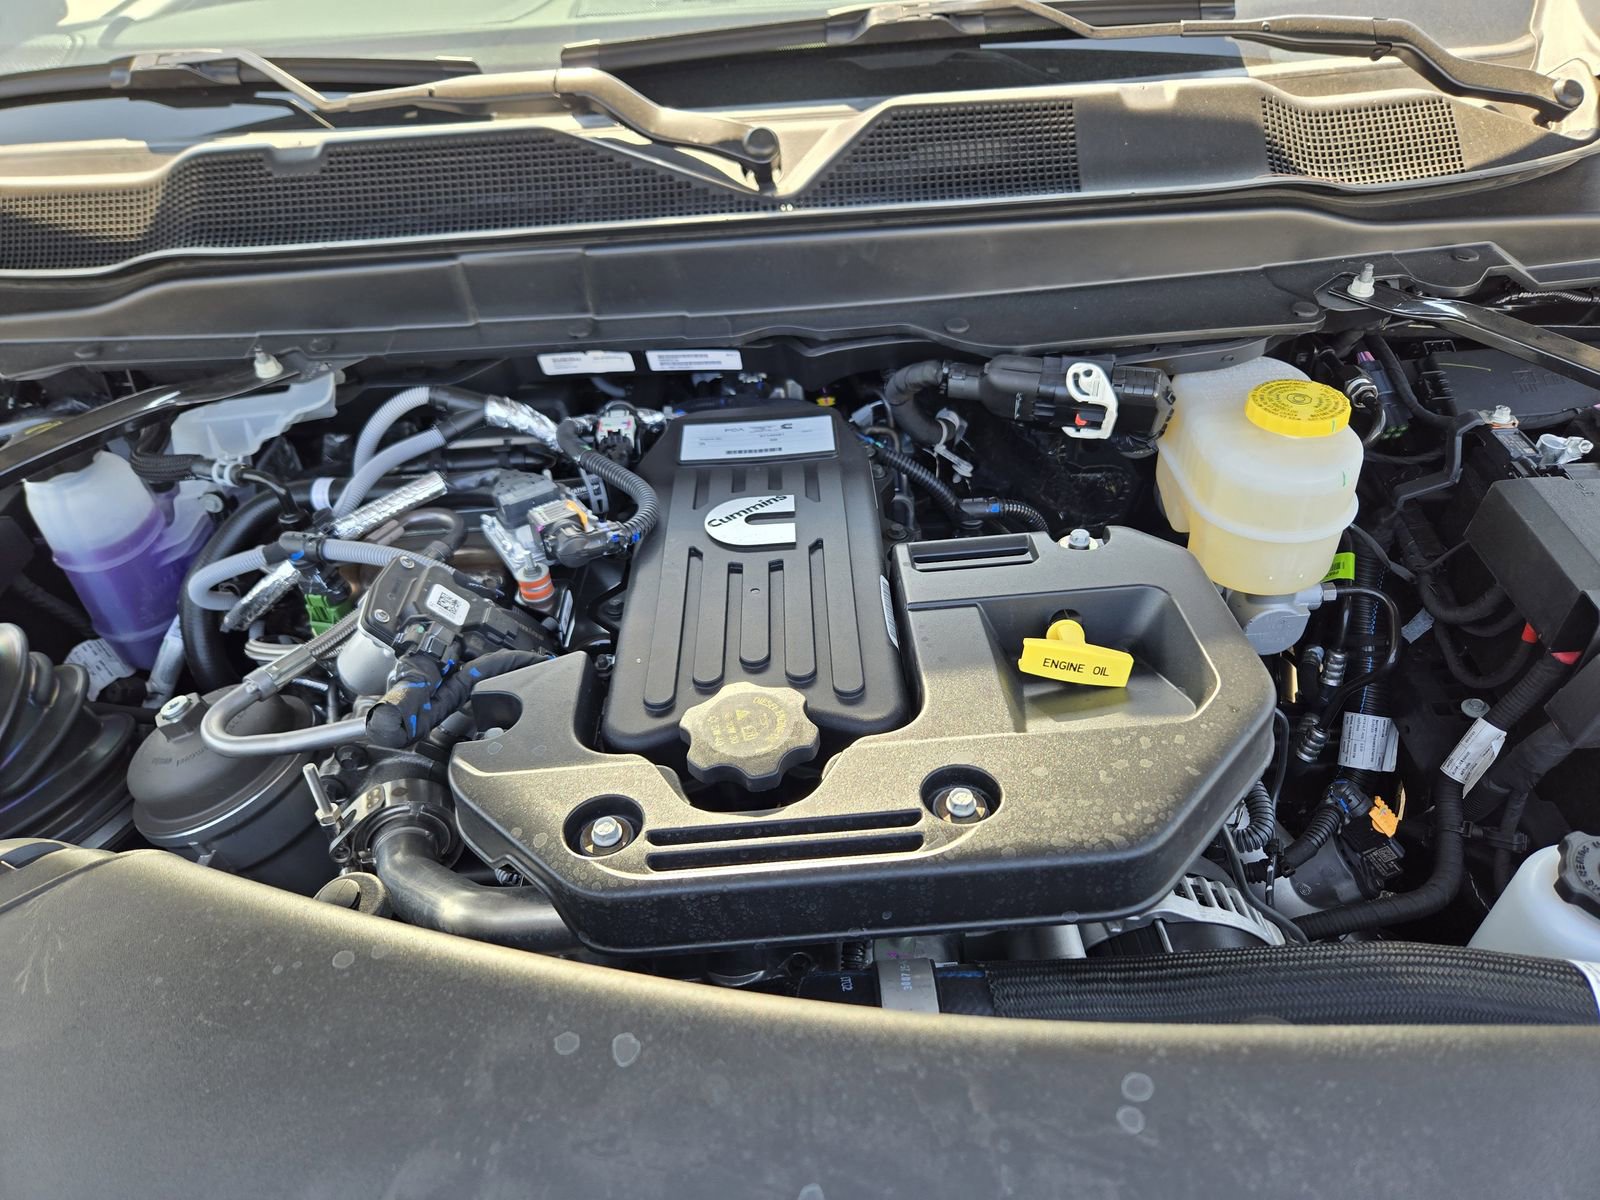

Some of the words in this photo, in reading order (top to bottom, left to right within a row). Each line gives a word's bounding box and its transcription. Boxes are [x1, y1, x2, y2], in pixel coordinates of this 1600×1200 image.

[707, 495, 788, 528] Cummins
[1042, 657, 1085, 674] ENGINE
[1092, 666, 1110, 677] OIL
